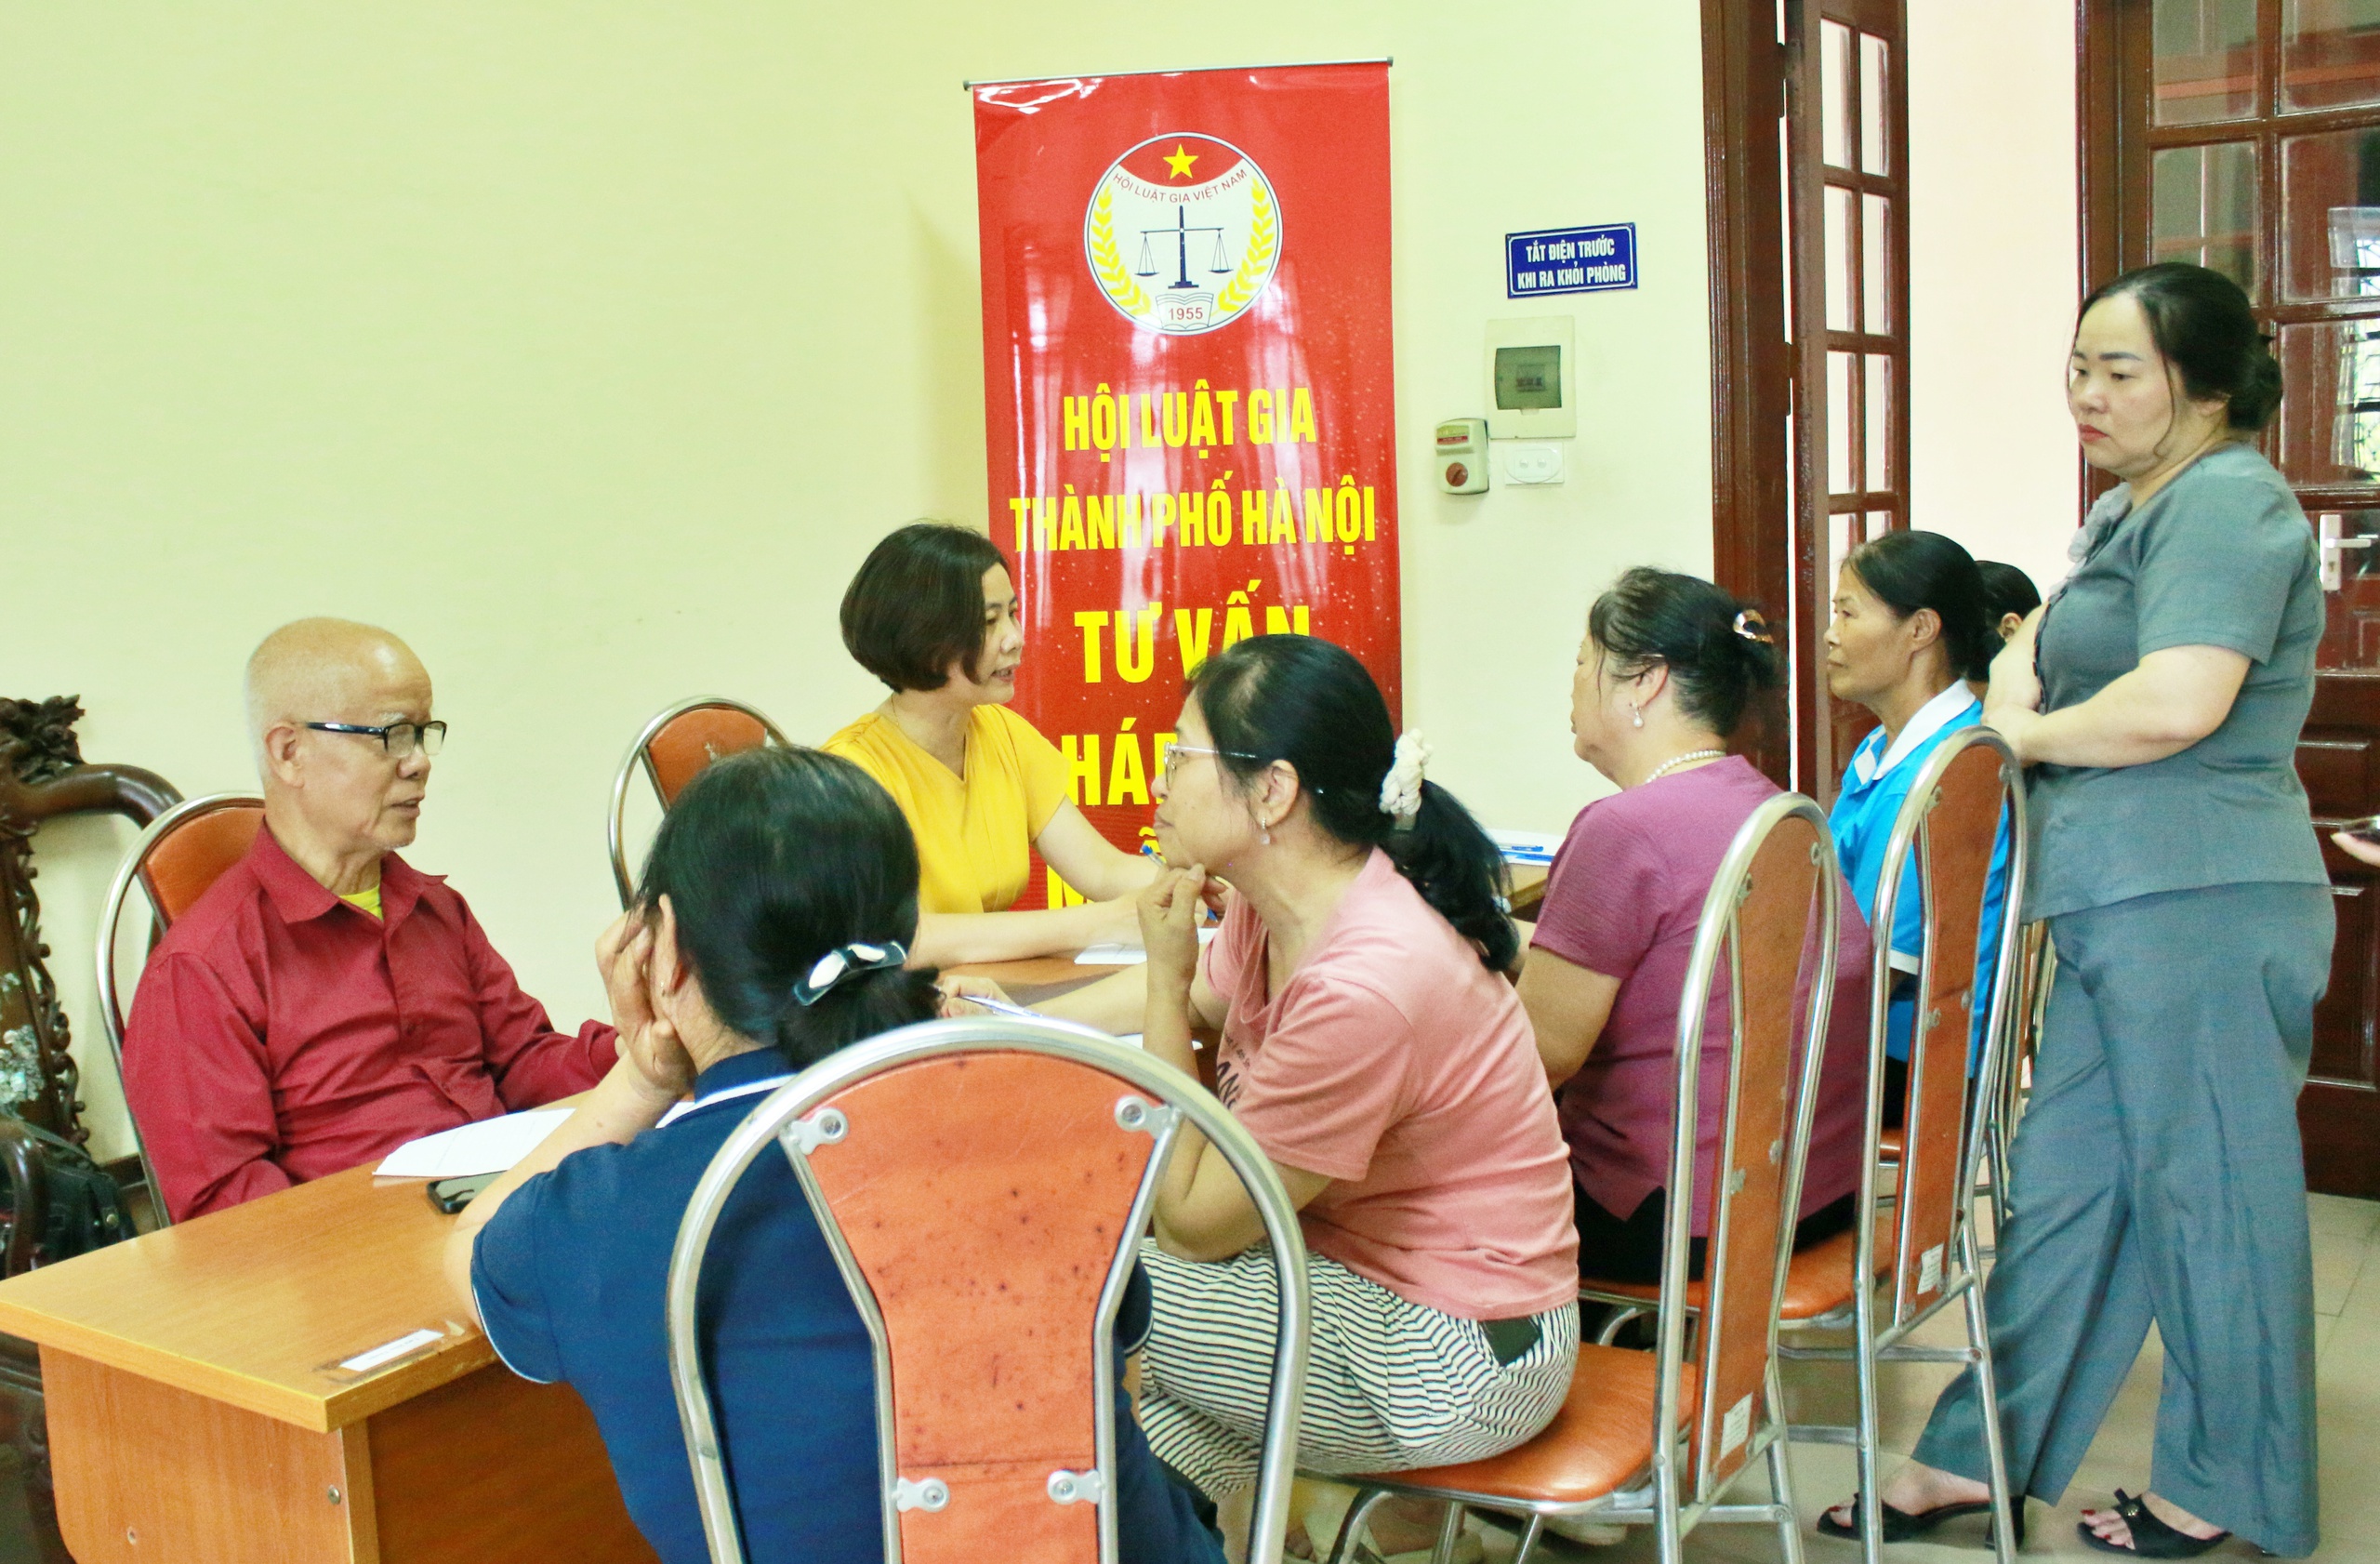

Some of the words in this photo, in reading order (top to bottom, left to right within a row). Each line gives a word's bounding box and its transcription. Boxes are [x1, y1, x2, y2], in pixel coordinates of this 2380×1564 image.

[1113, 173, 1134, 192] HỘI
[1134, 185, 1167, 203] LUẬT
[1169, 192, 1191, 204] GIA
[1193, 186, 1220, 201] VIỆT
[1222, 168, 1248, 191] NAM
[1526, 239, 1546, 263] TẮT
[1548, 239, 1576, 264] ĐIỆN
[1578, 234, 1616, 258] TRƯỚC
[1517, 272, 1537, 289] KHI
[1539, 270, 1555, 287] RA
[1557, 260, 1584, 286] KHỎI
[1586, 261, 1627, 285] PHÒNG
[1169, 307, 1203, 321] 1955
[1063, 383, 1130, 463] HỘI
[1140, 378, 1238, 459] LUẬT
[1248, 387, 1317, 445] GIA
[1010, 484, 1143, 553] THÀNH
[1152, 471, 1233, 549] PHỐ
[1242, 477, 1297, 546] HÀ
[1305, 474, 1376, 555] NỘI
[1074, 602, 1163, 683] TƯ
